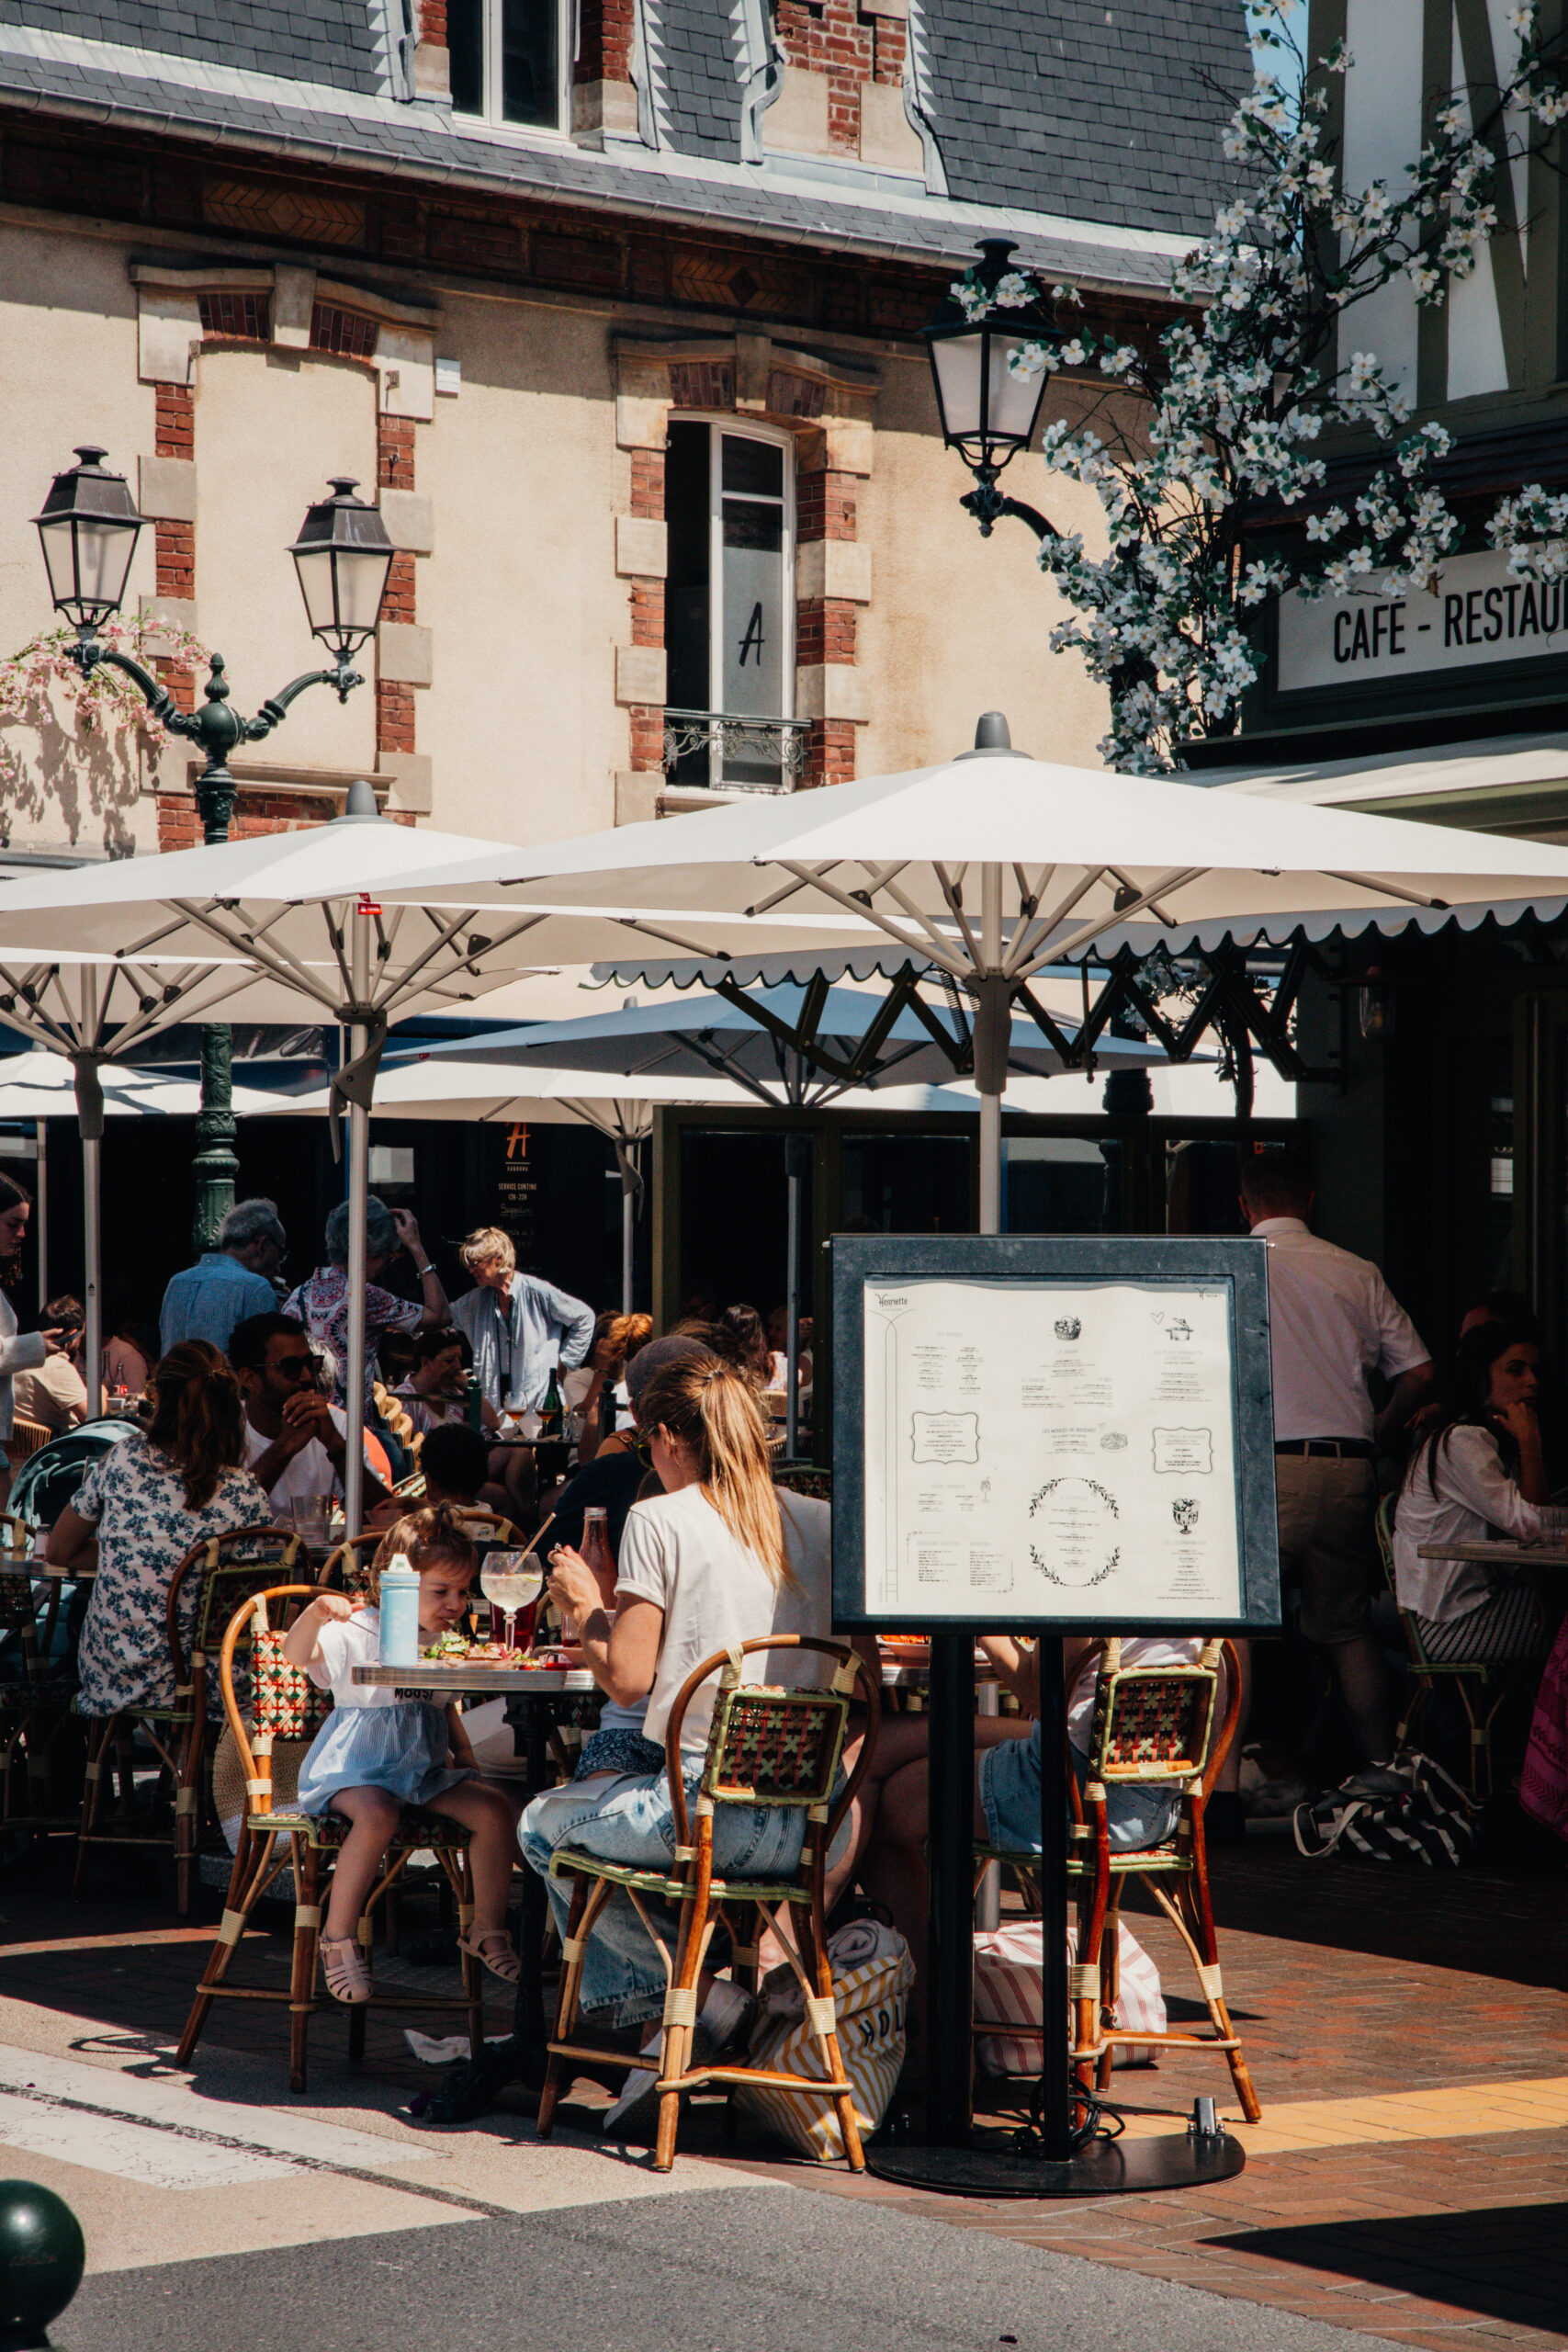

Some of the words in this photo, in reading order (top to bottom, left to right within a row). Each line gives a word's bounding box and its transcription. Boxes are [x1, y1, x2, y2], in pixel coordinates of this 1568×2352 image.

[738, 601, 765, 668] A
[498, 1182, 516, 1191] SERVICE
[517, 1182, 537, 1191] CONTINU
[874, 1294, 908, 1306] Henriette
